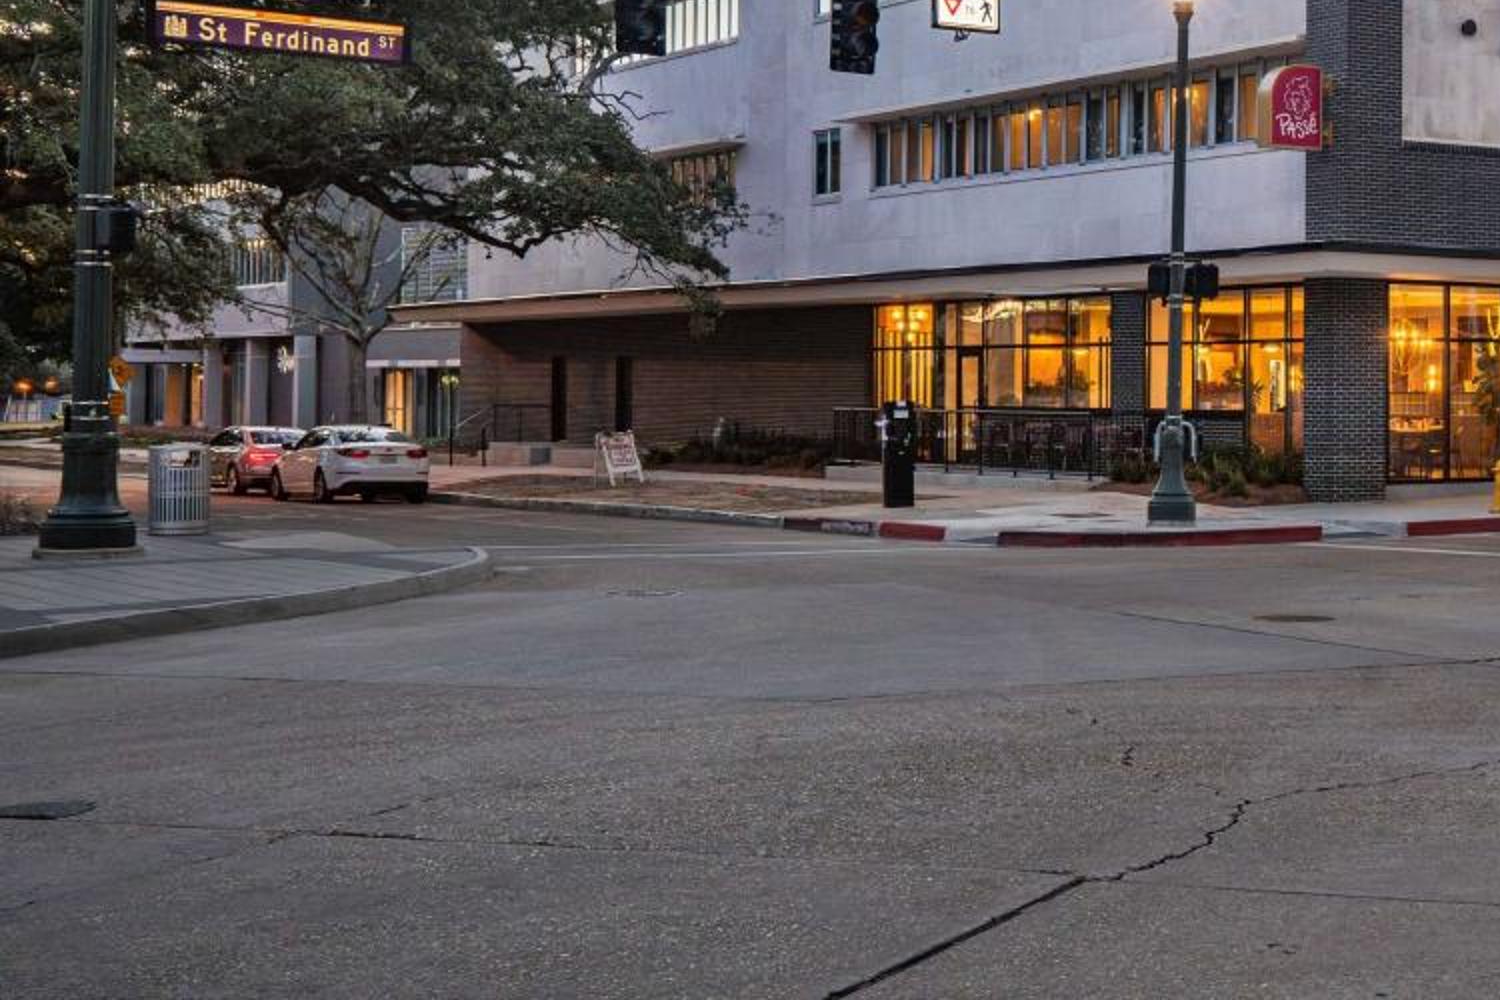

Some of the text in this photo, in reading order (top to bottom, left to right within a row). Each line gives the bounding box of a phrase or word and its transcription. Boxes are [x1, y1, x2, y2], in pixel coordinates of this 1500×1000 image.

[199, 18, 396, 56] St Ferdinand ST
